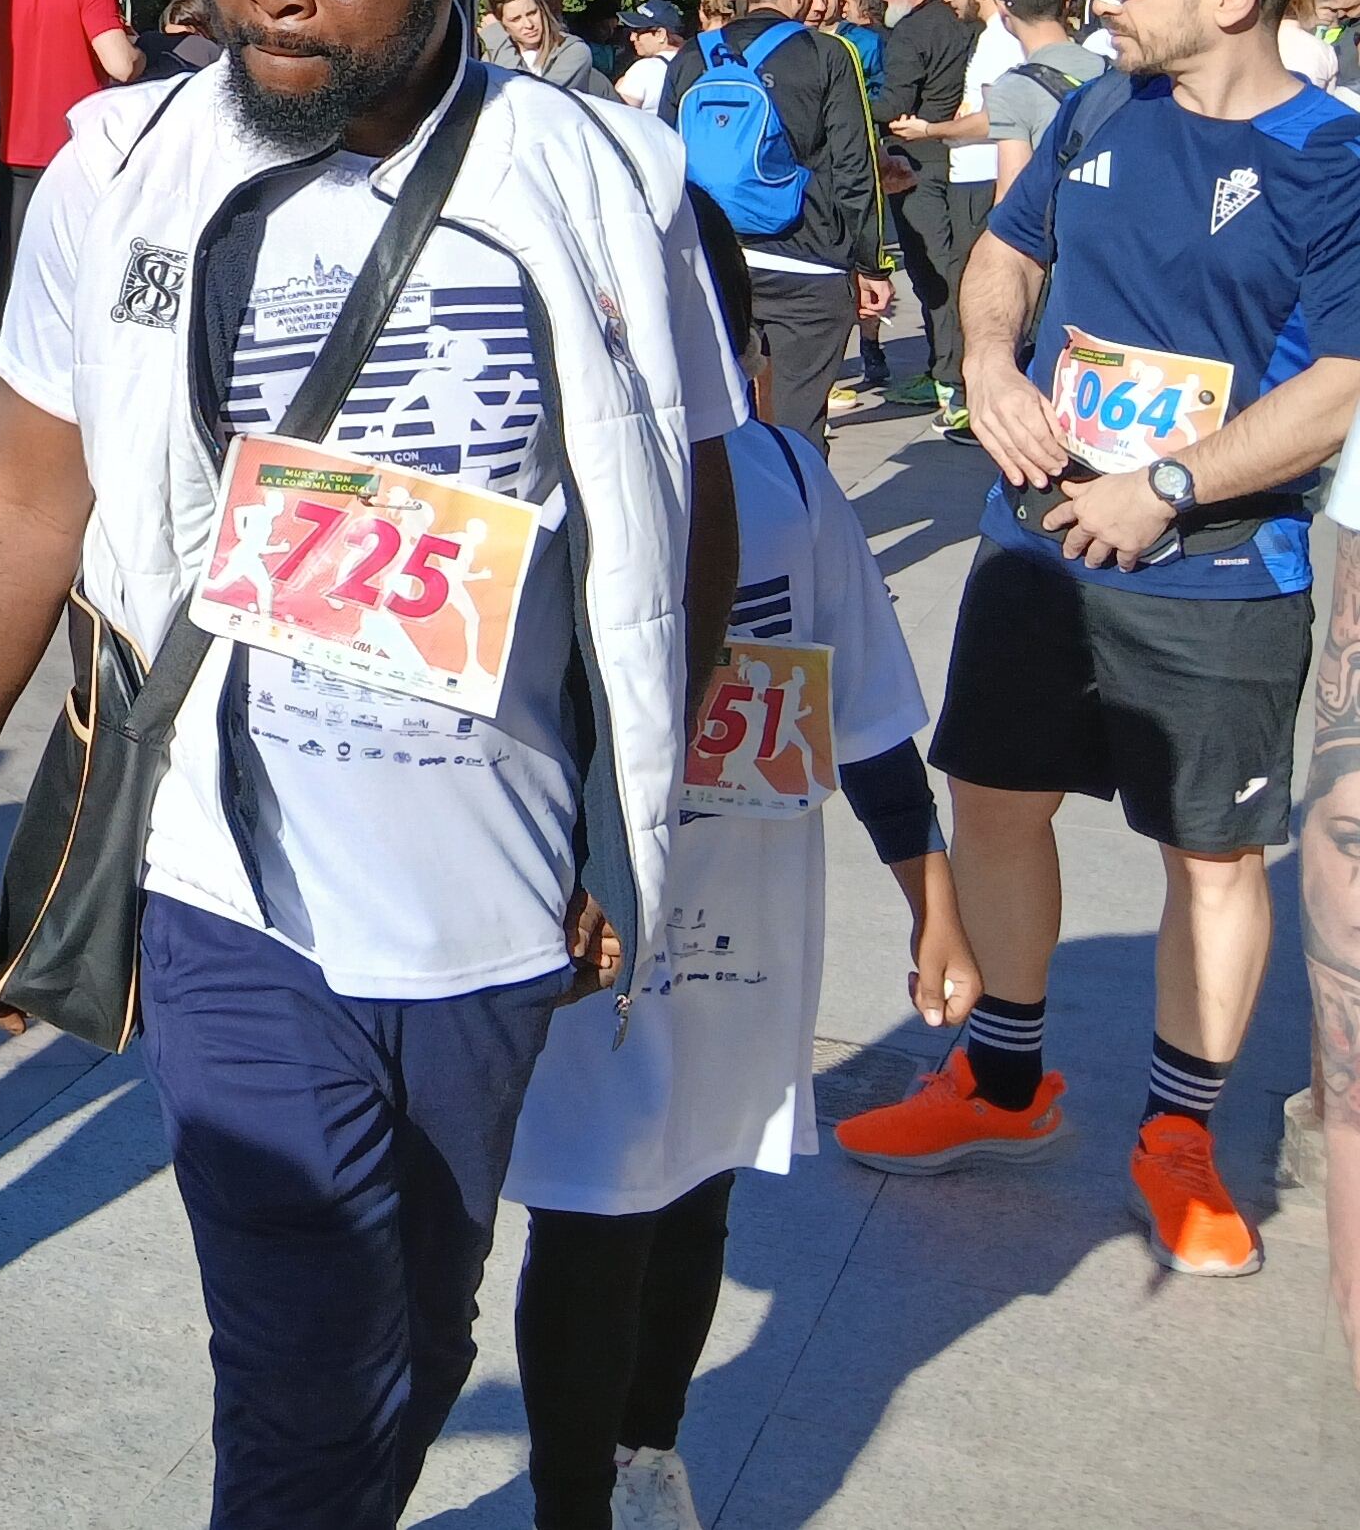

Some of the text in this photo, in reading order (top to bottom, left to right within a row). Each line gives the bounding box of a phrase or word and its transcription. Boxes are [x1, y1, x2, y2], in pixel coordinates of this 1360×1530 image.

[276, 311, 340, 328] AYUNTAMIEN
[1077, 370, 1183, 438] 064
[394, 450, 420, 462] CON
[260, 476, 274, 484] LA
[284, 469, 352, 484] MURCIA CON
[274, 500, 462, 619] 725
[694, 684, 784, 758] 51
